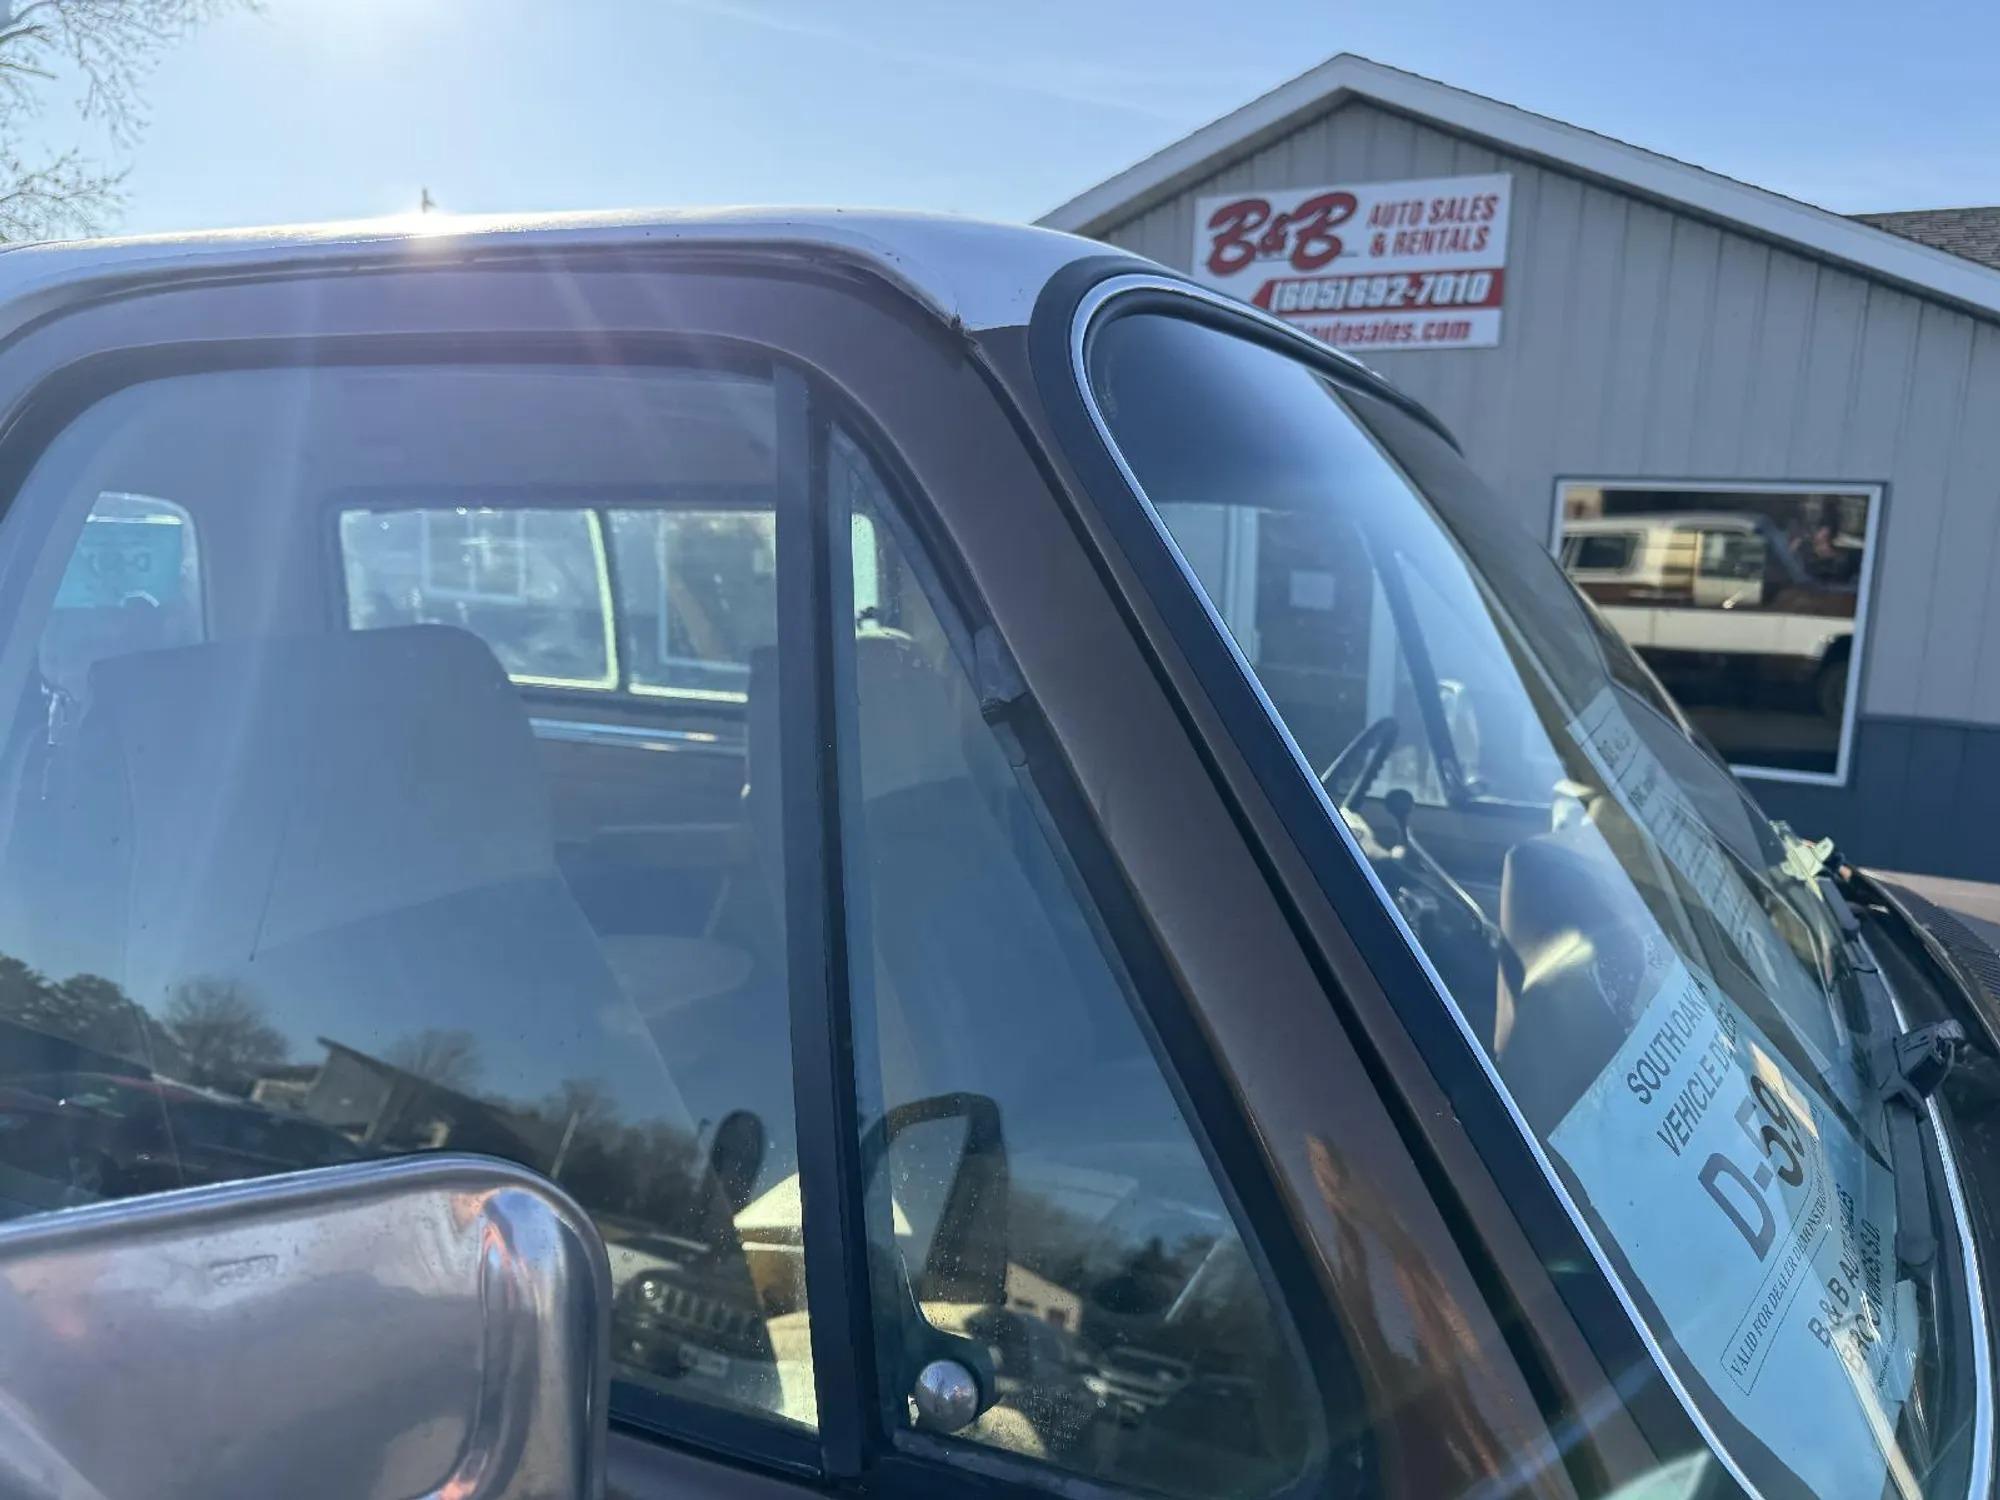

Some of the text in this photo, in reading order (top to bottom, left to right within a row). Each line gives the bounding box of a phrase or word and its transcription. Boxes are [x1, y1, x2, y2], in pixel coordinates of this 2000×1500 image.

[1366, 193, 1498, 229] AUTO SALES
[1368, 225, 1489, 257] & RENTALS
[1626, 1021, 1687, 1105] SOUTH
[1656, 1054, 1724, 1157] VEHICLE
[1827, 1276, 1850, 1308] B
[1730, 1331, 1759, 1376] VALID
[1752, 1303, 1774, 1337] FOR
[1767, 1255, 1799, 1310] DEALER
[1819, 1299, 1843, 1326] &
[1807, 1316, 1832, 1349] B
